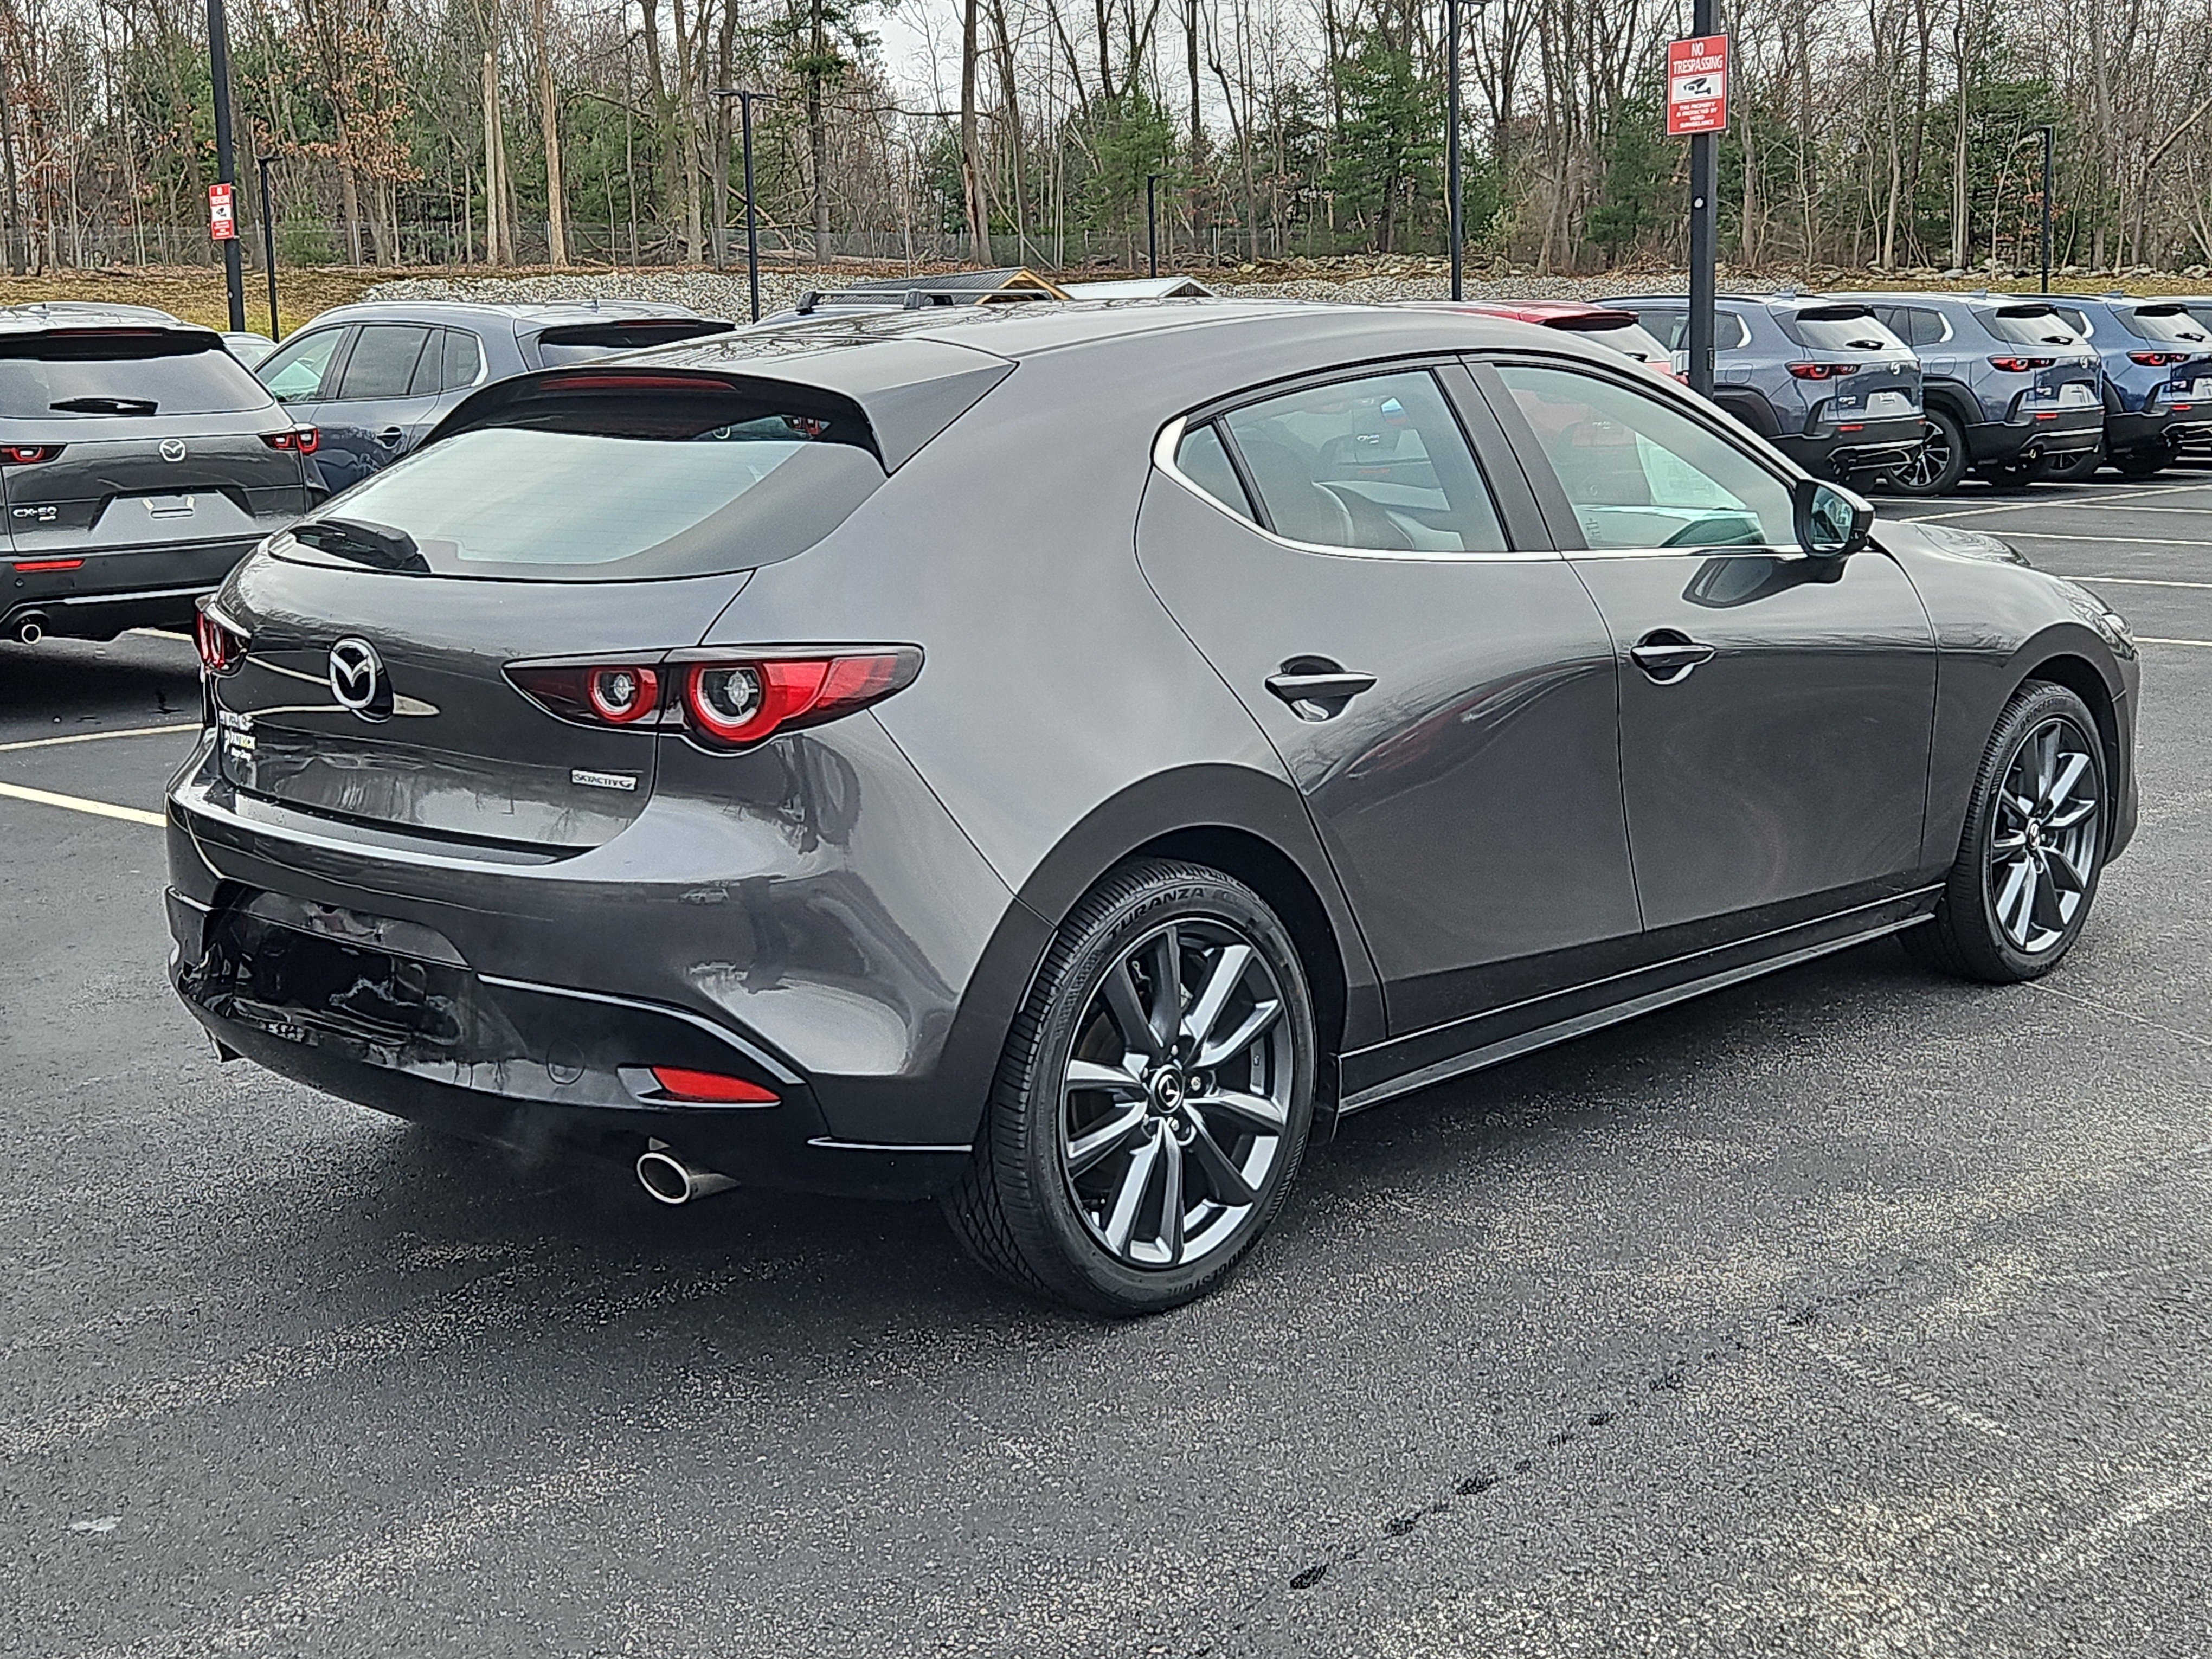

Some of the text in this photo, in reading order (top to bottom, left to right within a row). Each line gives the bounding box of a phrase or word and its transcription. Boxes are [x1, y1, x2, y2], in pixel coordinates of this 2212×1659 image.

[1691, 42, 1705, 57] NO
[1673, 54, 1723, 75] TRESPASSING
[12, 506, 57, 517] CX-50
[1108, 887, 1204, 940] TURANZA
